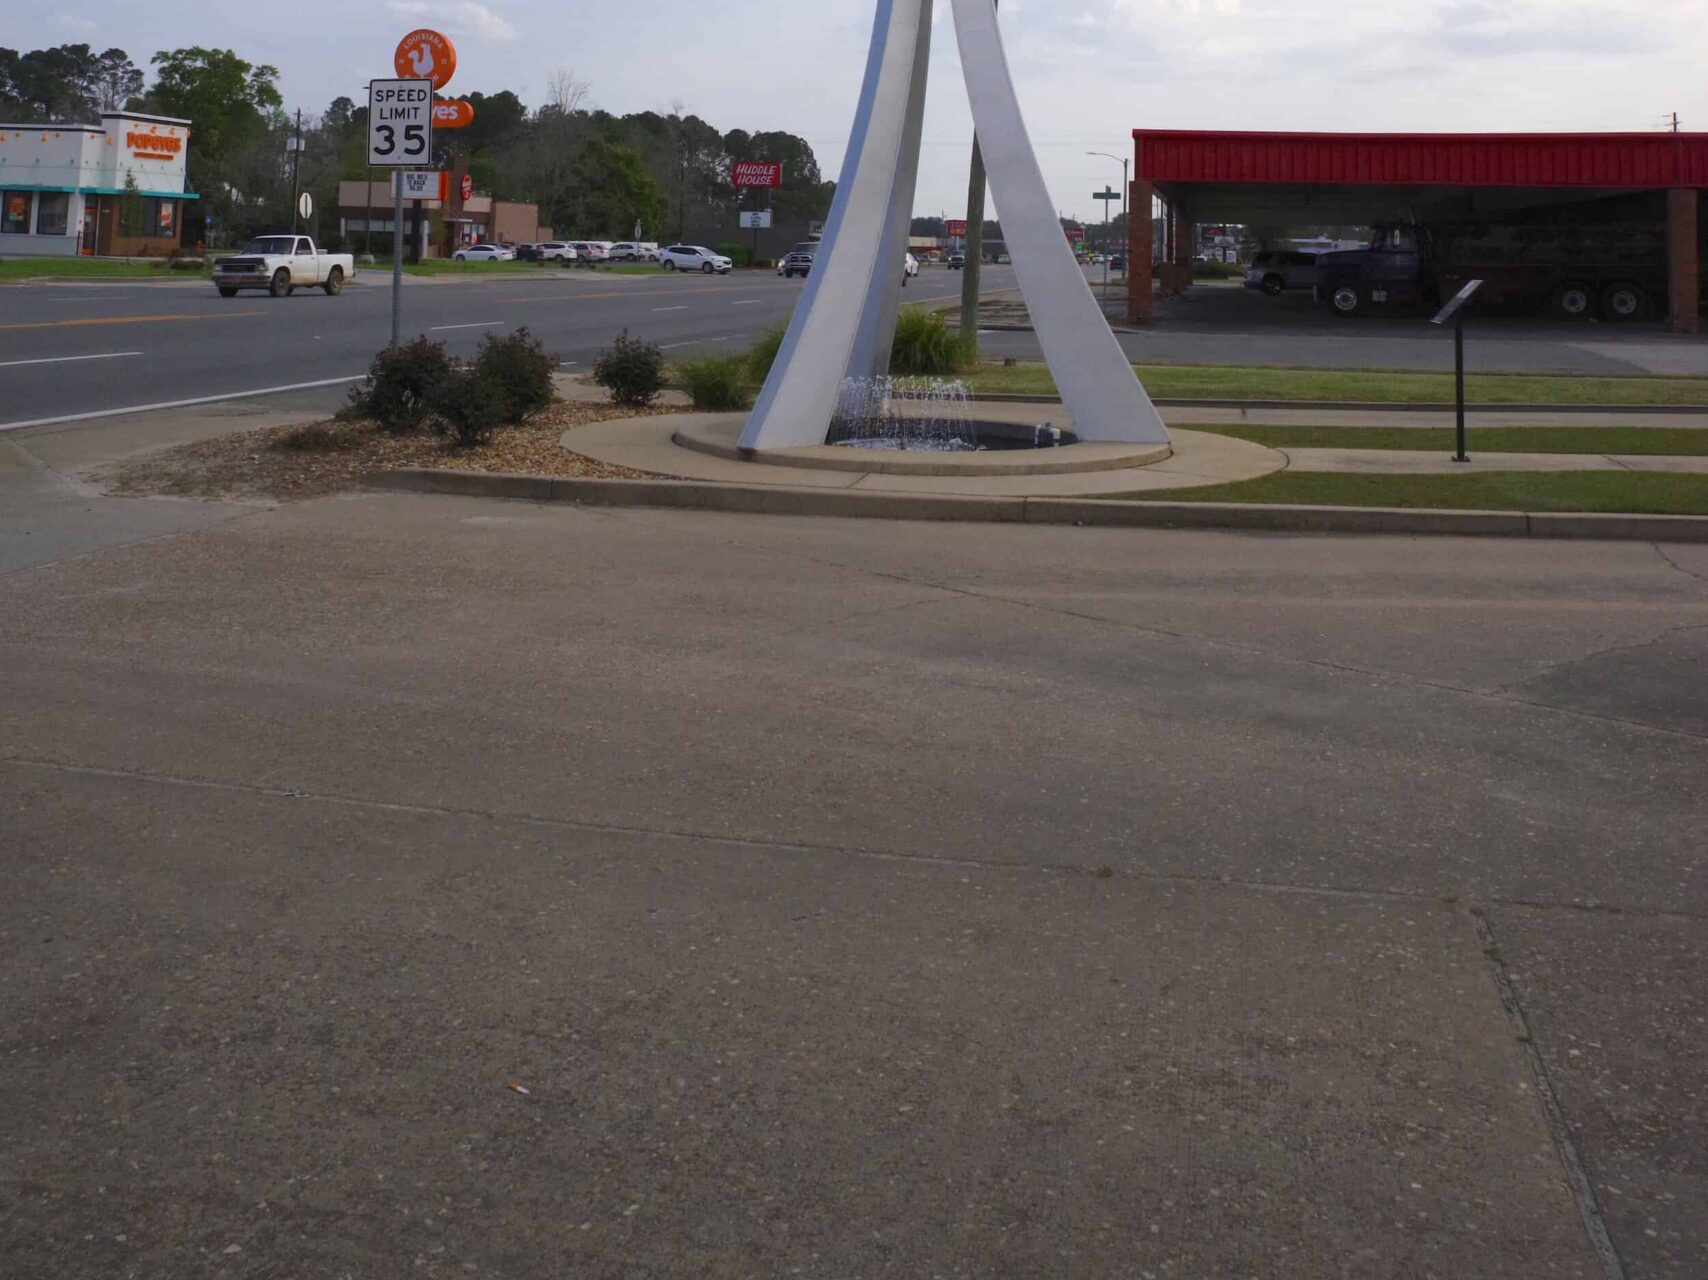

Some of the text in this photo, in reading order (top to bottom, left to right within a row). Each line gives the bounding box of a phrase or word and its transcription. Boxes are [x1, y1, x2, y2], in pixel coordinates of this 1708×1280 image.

[375, 89, 427, 103] SPEED
[379, 106, 421, 120] LIMIT
[373, 124, 426, 156] 35
[736, 164, 777, 175] HUDDLE
[737, 175, 774, 185] HOUSE
